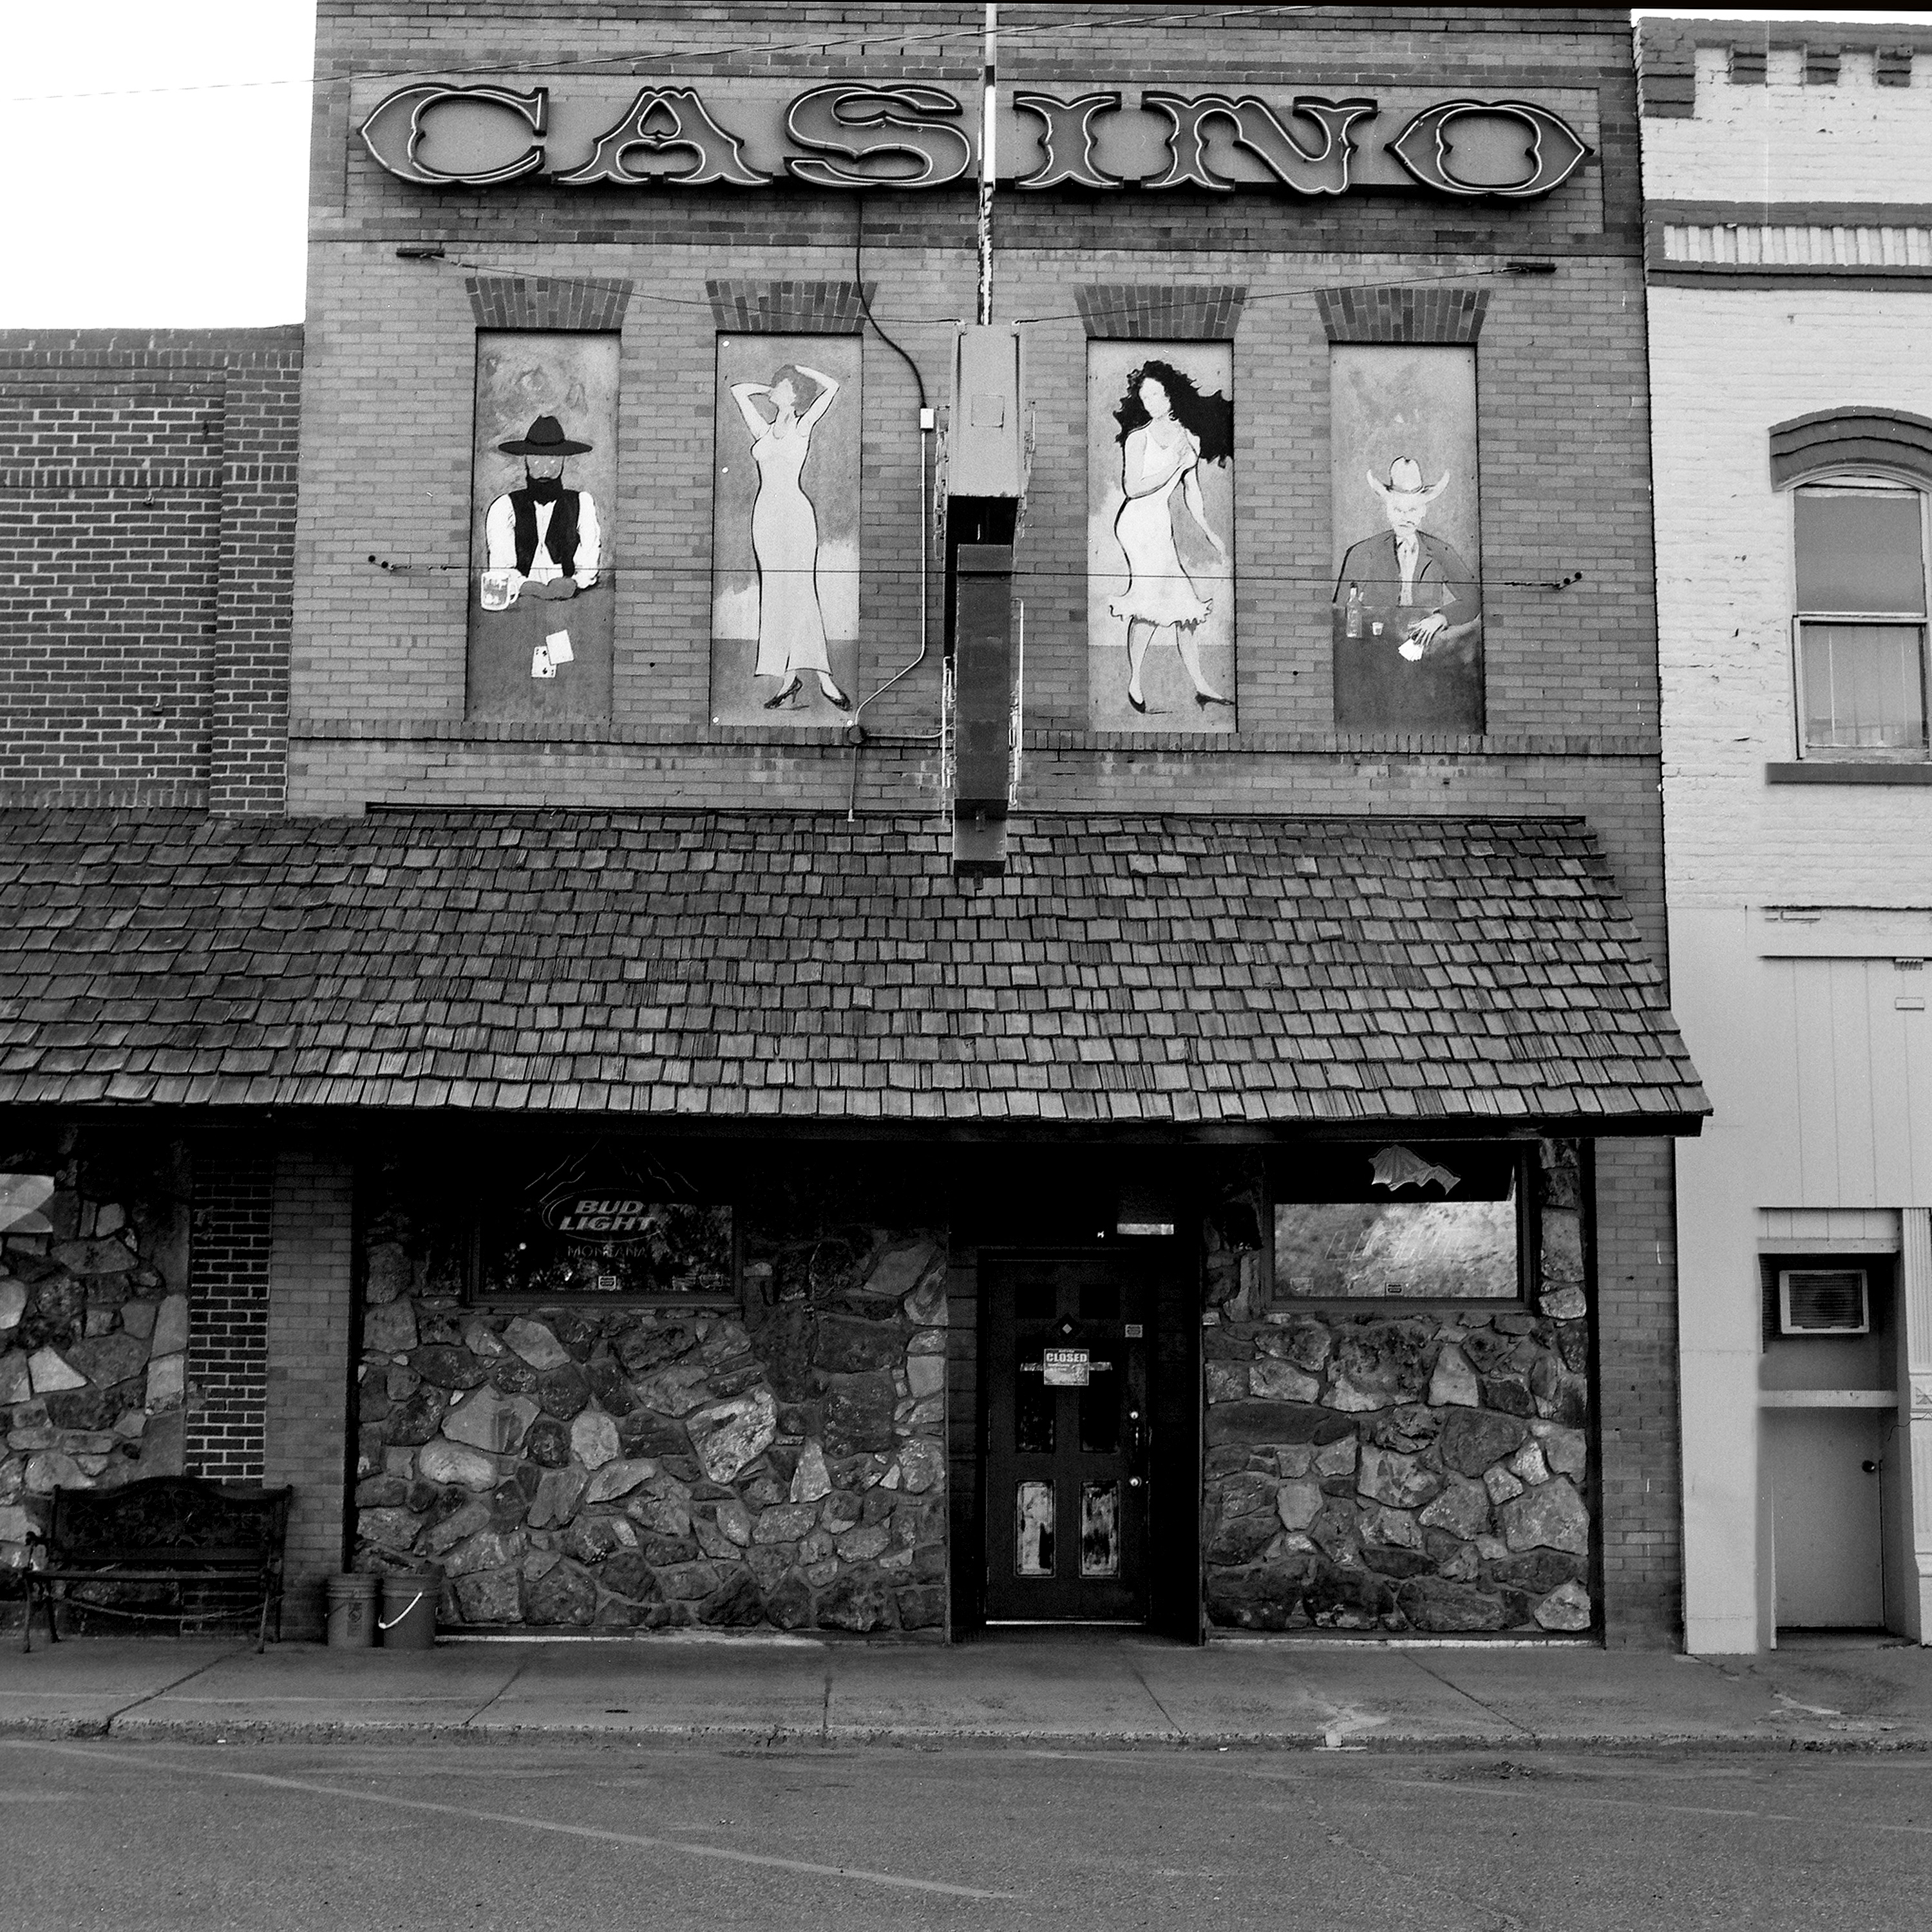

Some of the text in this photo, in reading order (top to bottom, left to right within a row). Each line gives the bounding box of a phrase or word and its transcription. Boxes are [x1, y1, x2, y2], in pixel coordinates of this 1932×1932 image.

[357, 82, 1594, 198] CASINO
[575, 1200, 645, 1214] BUD
[558, 1216, 655, 1231] LIGHT
[1046, 1352, 1087, 1362] CLOSED
